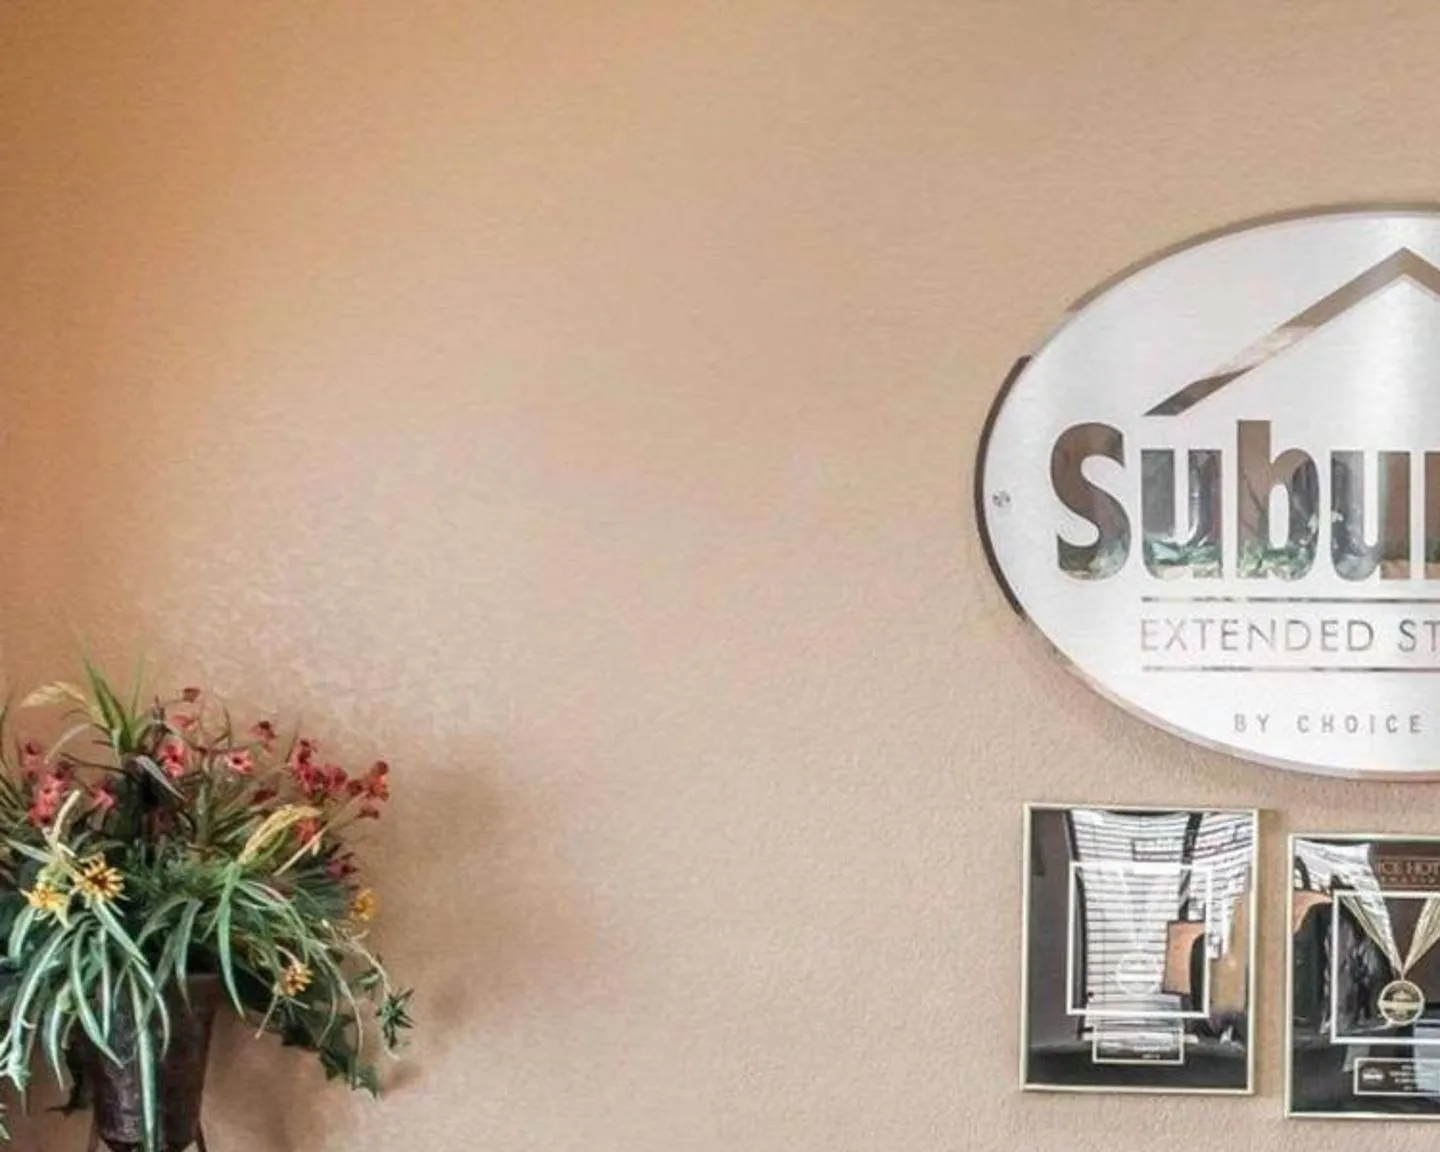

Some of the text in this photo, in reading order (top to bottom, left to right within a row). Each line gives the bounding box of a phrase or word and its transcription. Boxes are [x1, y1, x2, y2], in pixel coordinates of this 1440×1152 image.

[1140, 618, 1374, 652] EXTENDED
[1233, 713, 1270, 733] BY
[1296, 714, 1422, 734] CHOICE
